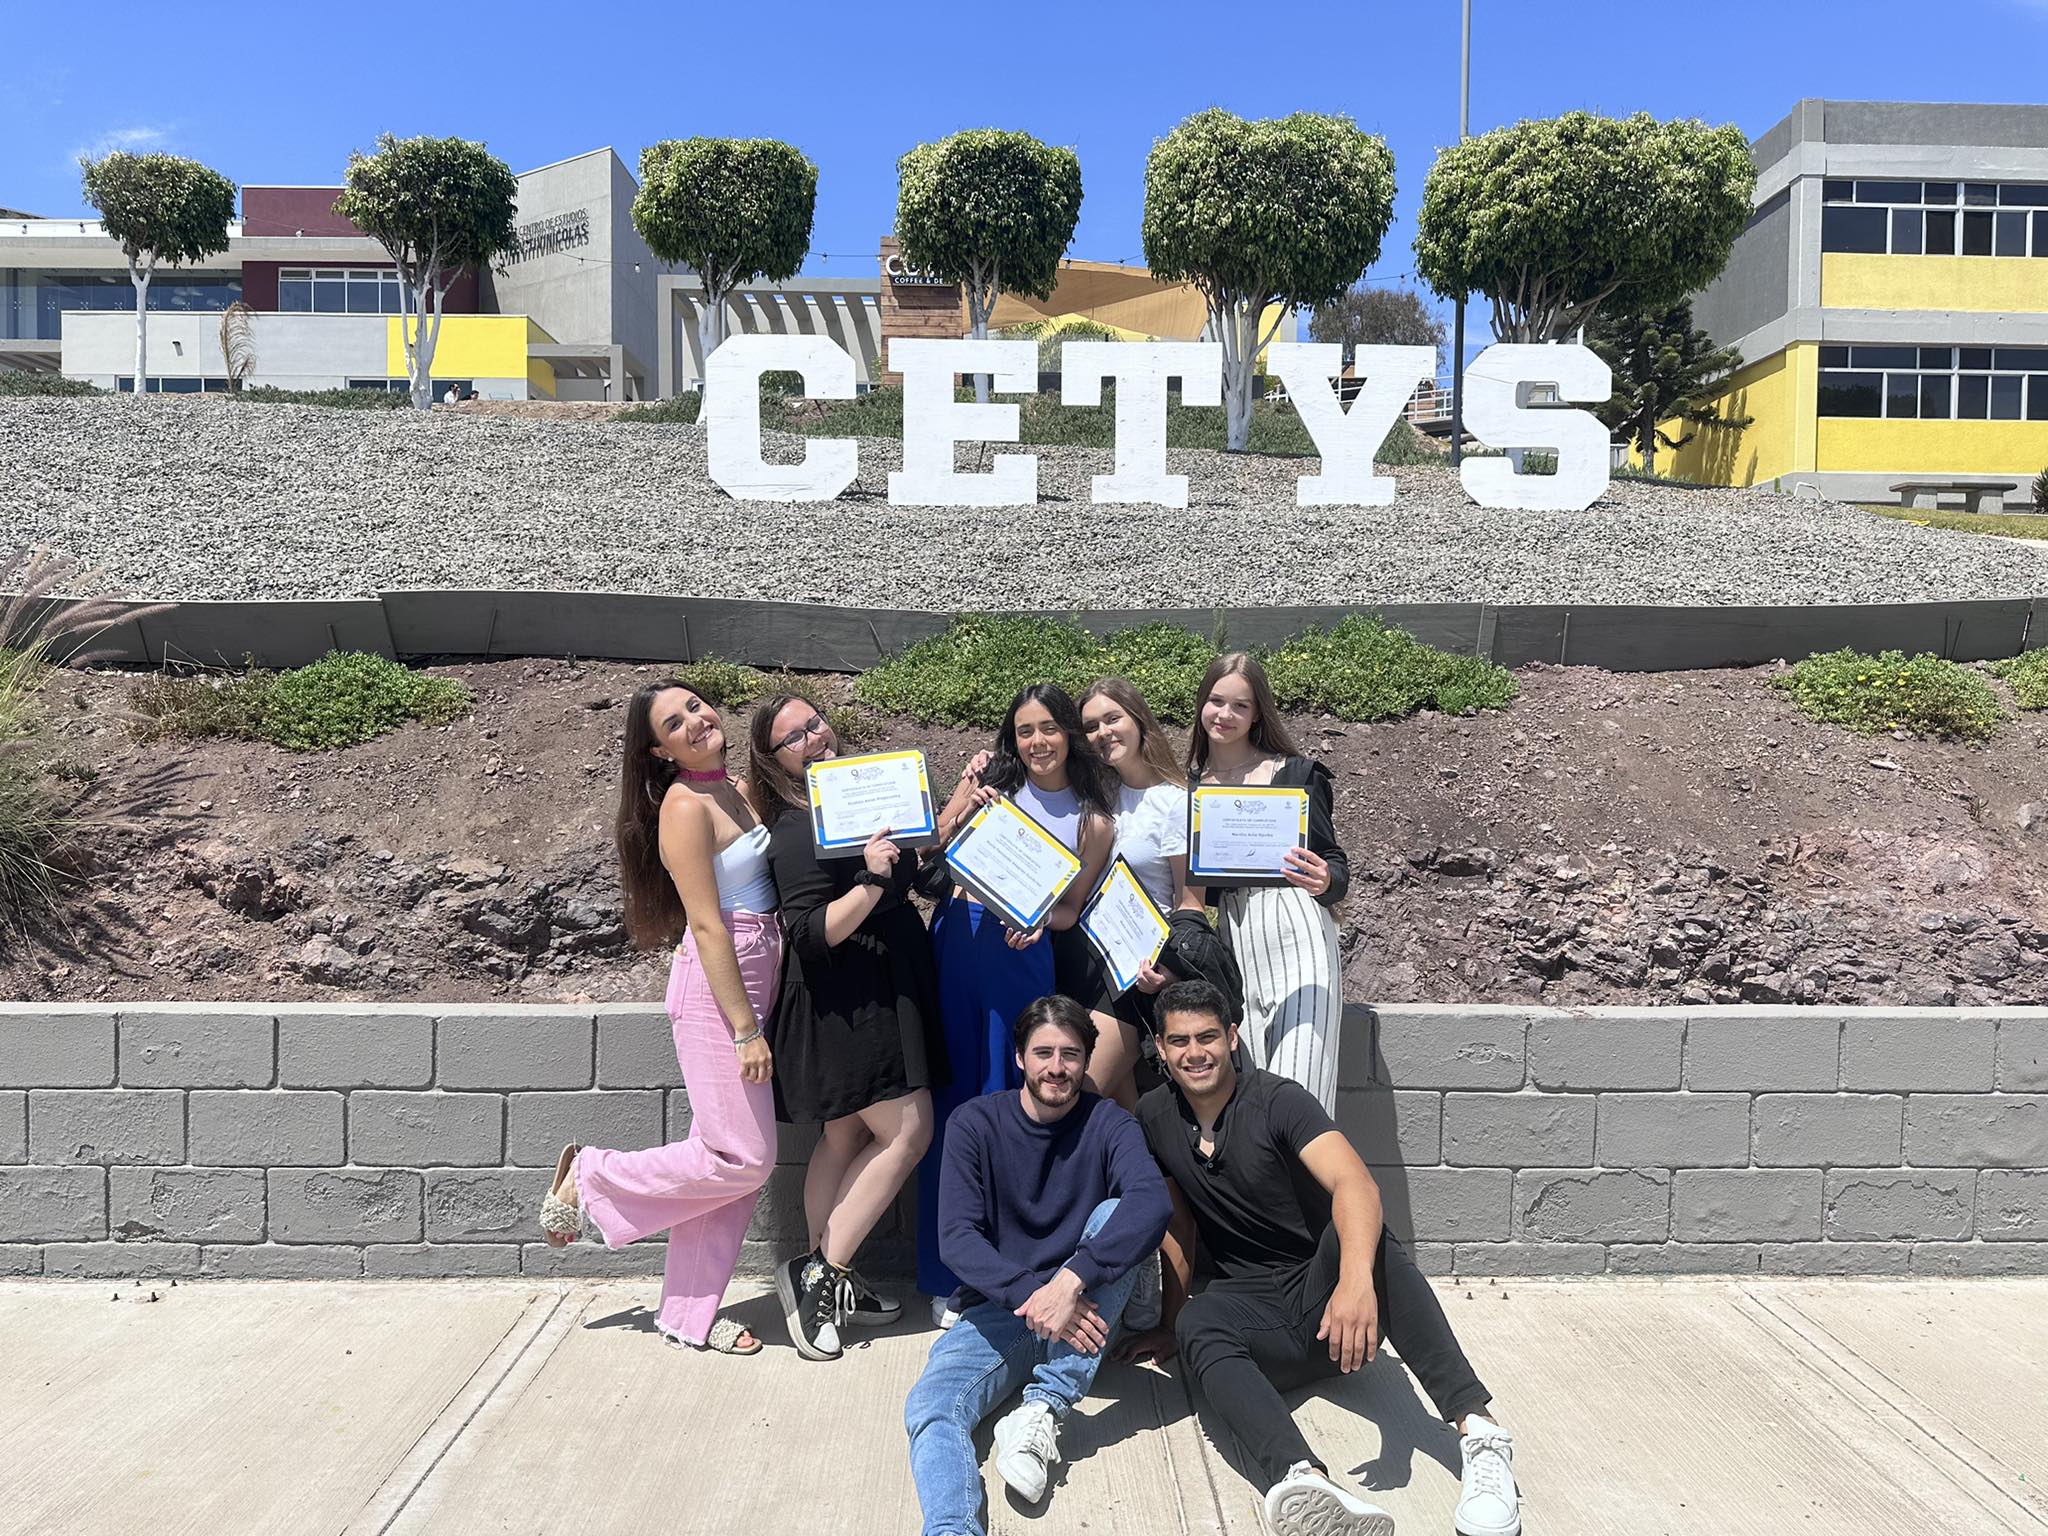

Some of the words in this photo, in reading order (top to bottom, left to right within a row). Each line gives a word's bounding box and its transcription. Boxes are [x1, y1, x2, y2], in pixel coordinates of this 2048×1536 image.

[519, 221, 544, 236] CENTRO
[545, 218, 554, 230] DE
[555, 208, 587, 227] ESTUDIOS
[705, 333, 1612, 510] CETYS
